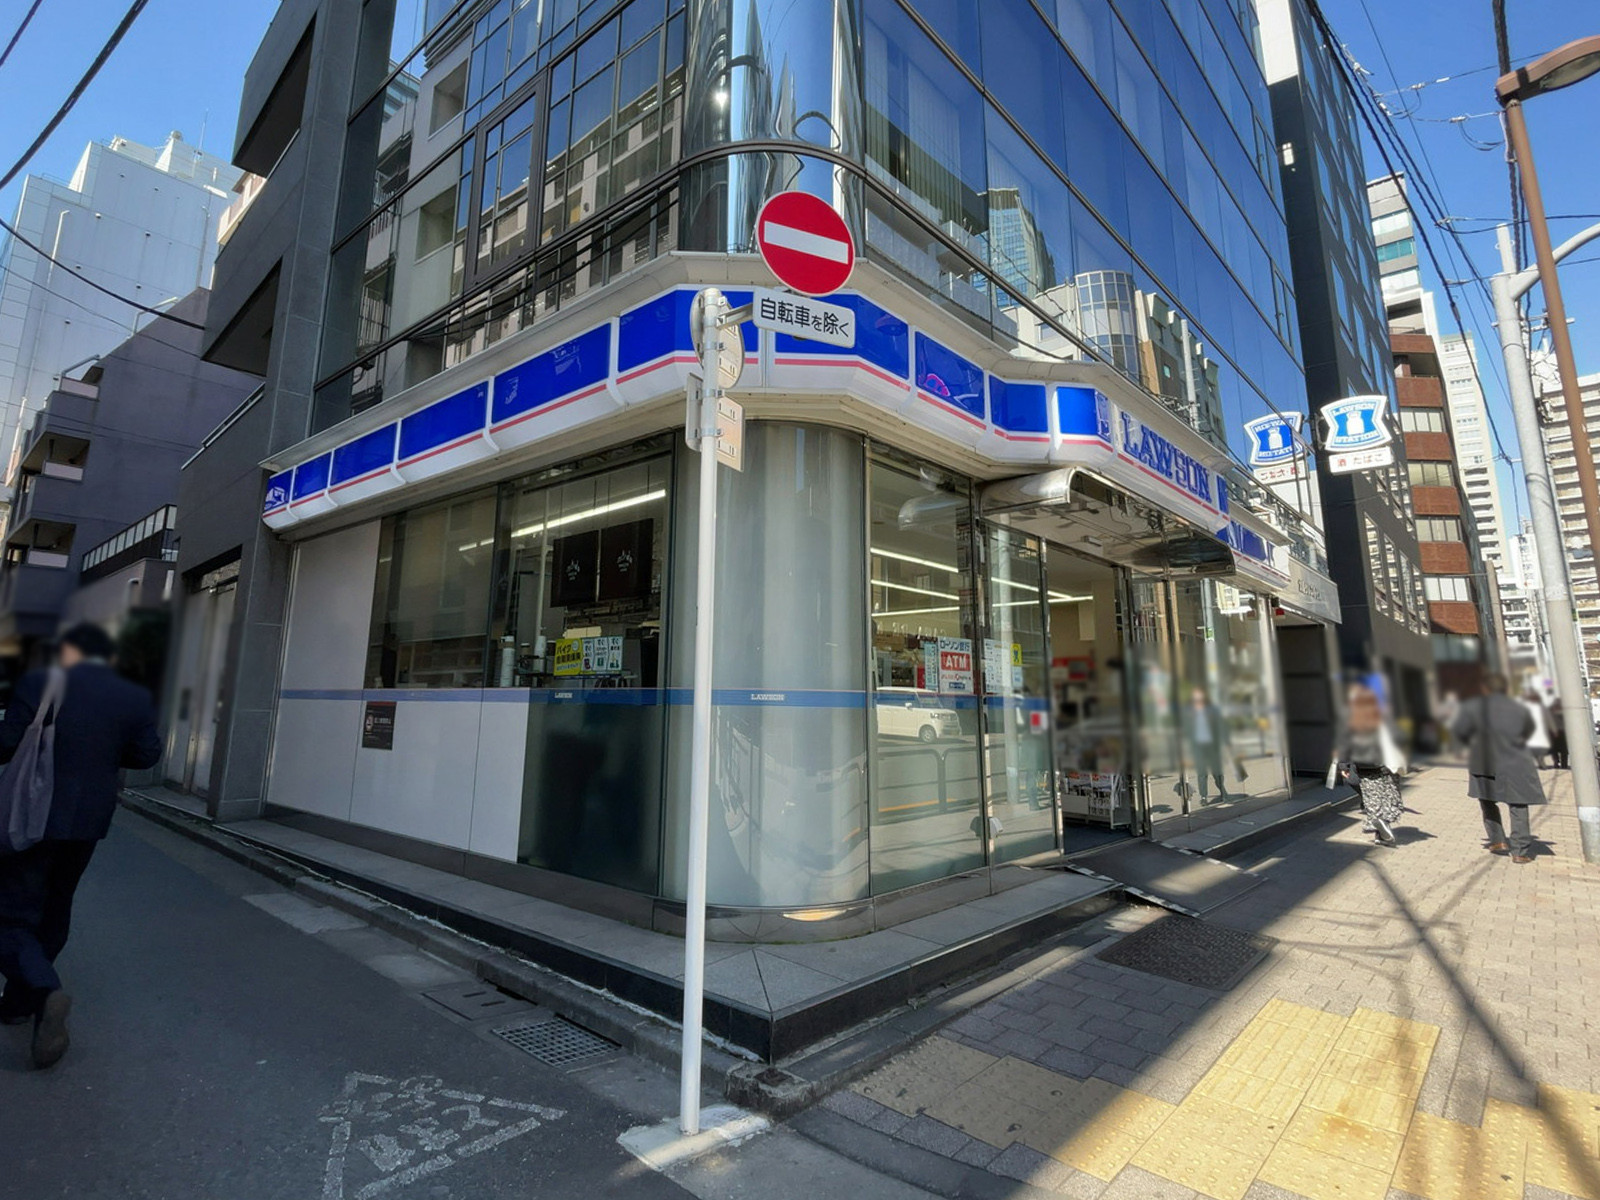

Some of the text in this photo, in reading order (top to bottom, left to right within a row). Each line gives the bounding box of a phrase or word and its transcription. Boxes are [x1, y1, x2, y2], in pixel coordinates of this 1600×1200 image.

[761, 297, 849, 337] 自転車を除く
[1333, 404, 1376, 416] LAWSON
[1120, 411, 1212, 503] LAWSON
[946, 655, 966, 668] ATM
[751, 693, 784, 701] LAWSON
